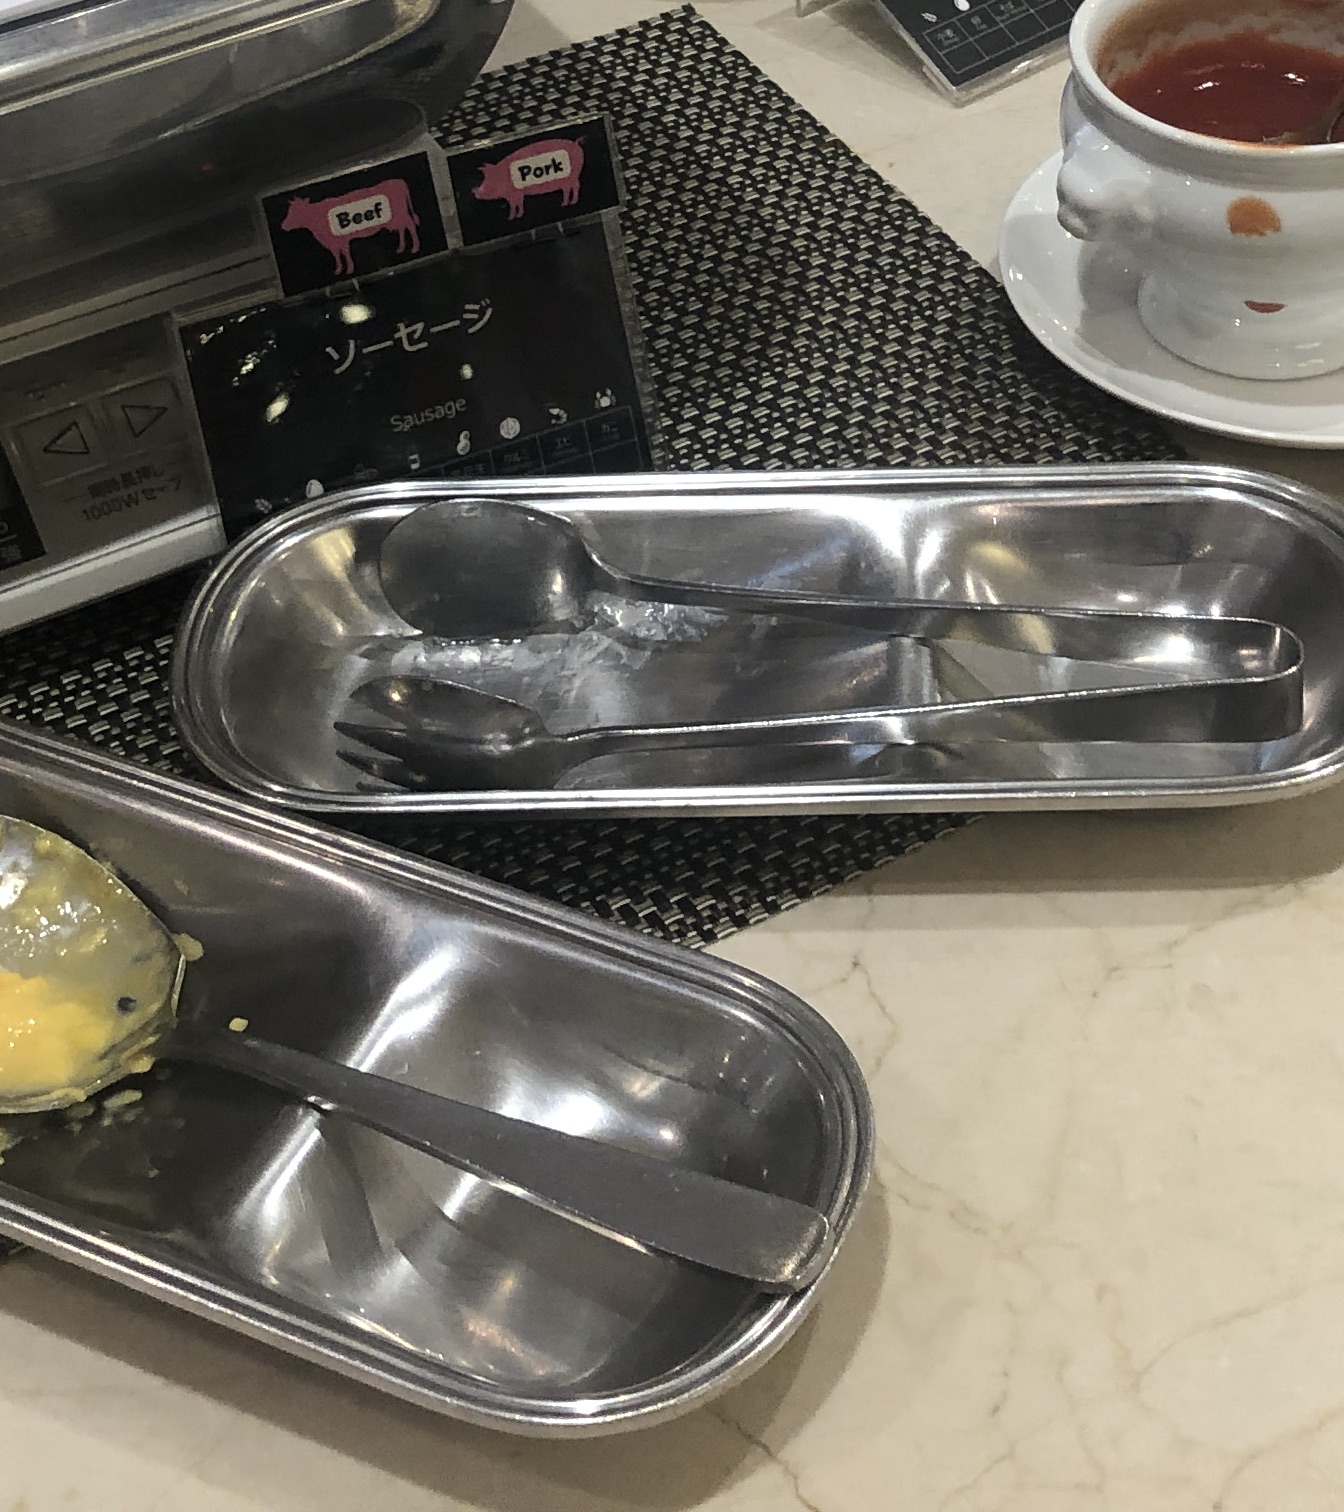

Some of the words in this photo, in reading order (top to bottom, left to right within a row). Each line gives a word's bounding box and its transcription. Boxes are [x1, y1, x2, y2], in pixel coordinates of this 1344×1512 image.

[517, 157, 564, 182] Pork
[335, 202, 383, 230] Beef
[325, 298, 494, 375] ソーセージ
[390, 396, 467, 434] Sausage
